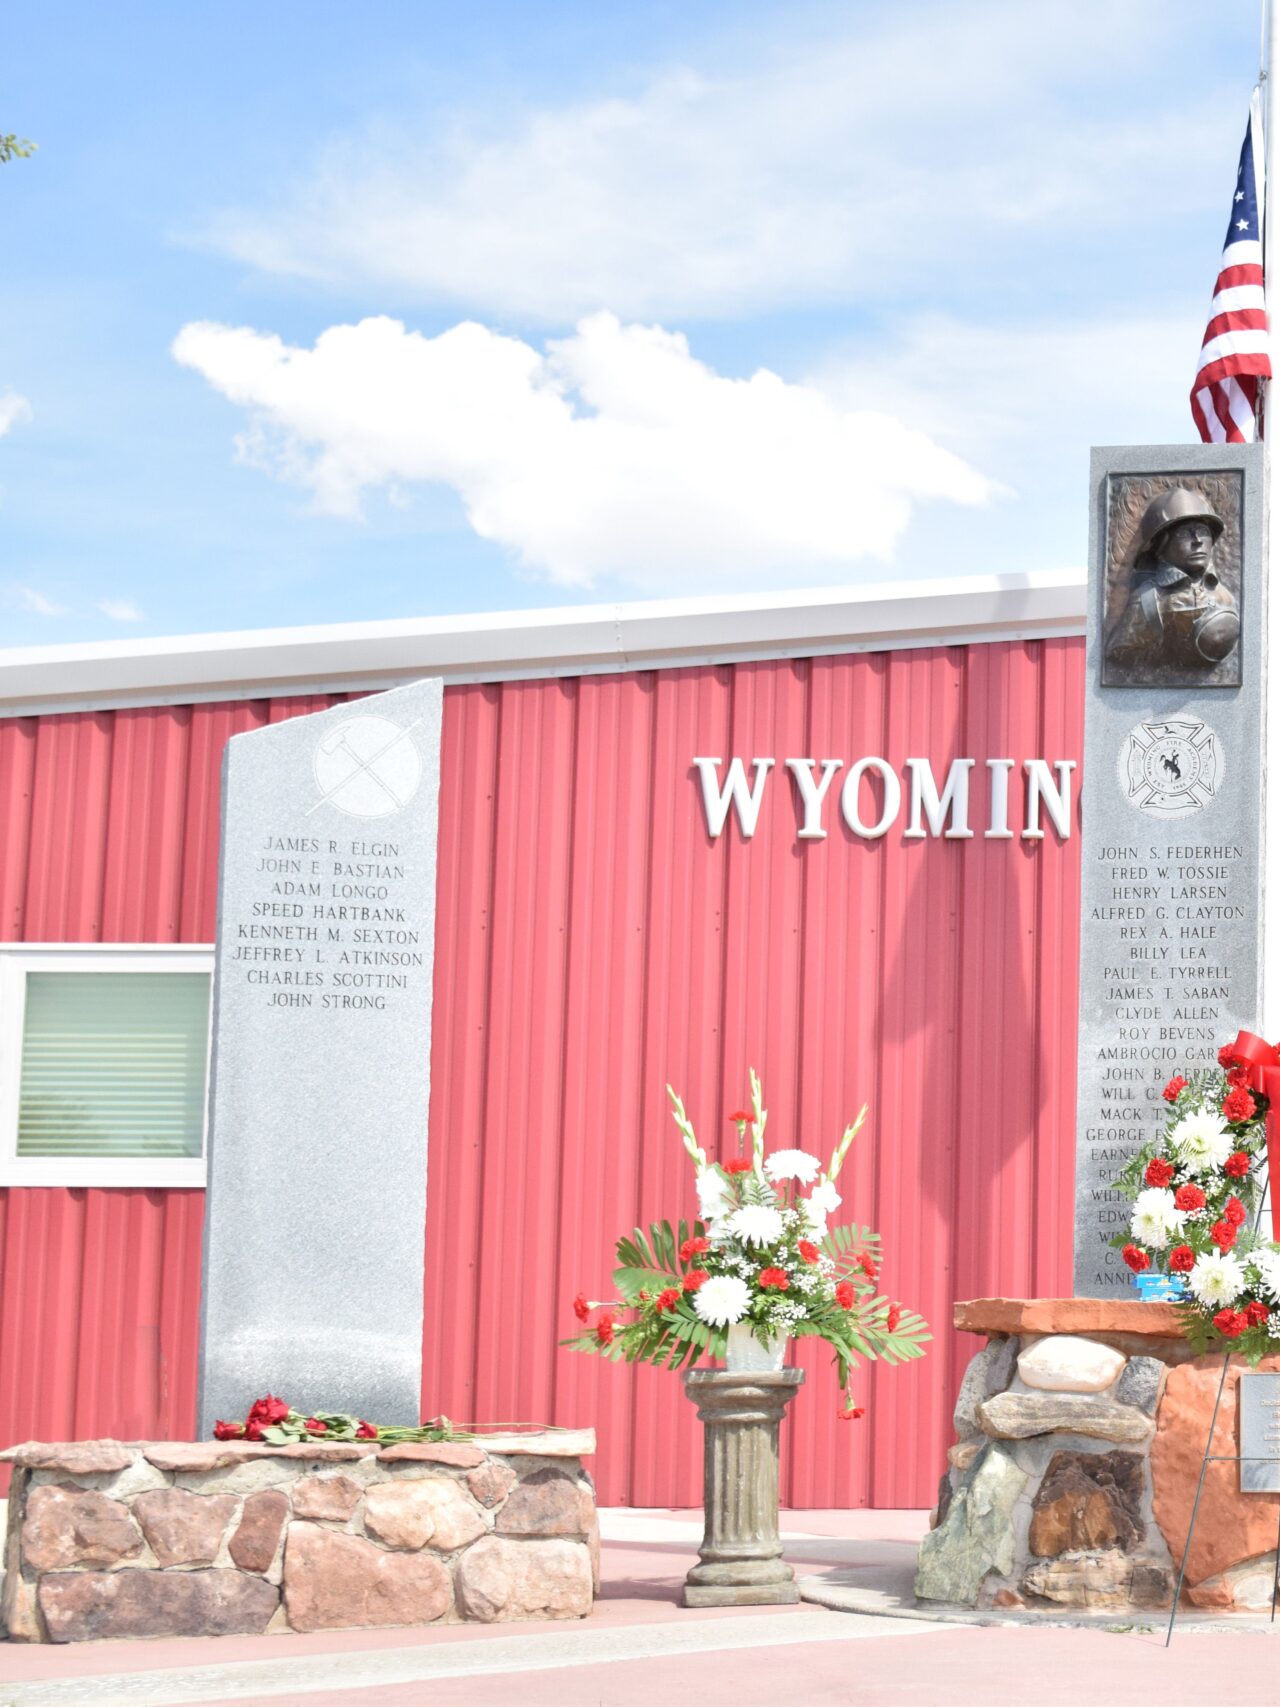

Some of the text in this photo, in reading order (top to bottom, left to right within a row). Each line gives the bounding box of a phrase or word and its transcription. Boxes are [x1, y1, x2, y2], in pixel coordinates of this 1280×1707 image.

[693, 756, 1077, 840] WYOMIN
[264, 837, 319, 852] JAMES
[352, 842, 399, 856] ELGIN
[1098, 848, 1138, 860] JOHN
[1167, 847, 1243, 859] FEDERHEN
[256, 858, 301, 872] JOHN
[333, 862, 404, 878] BASTIAN
[1112, 867, 1148, 879] FRED
[1177, 867, 1228, 879] TOSSIE
[271, 882, 388, 900] ADAM LONGO
[1113, 886, 1227, 899] HENRY LARSEN
[253, 903, 405, 922] SPEED HARTBANK
[1091, 907, 1145, 919] ALFRED
[1176, 906, 1245, 919] CLAYTON
[238, 924, 317, 940] KENNETH
[353, 929, 419, 944] SEXTON
[1120, 927, 1147, 938] REX
[1180, 926, 1217, 938] HALE
[232, 946, 306, 962] JEFFREY
[339, 951, 423, 966] ATKINSON
[1130, 947, 1207, 959] BILLY LEA
[247, 970, 407, 988] CHARLES SCOTTINI
[1104, 968, 1139, 979] PAUL
[1170, 967, 1231, 979] TYRRELL
[1106, 988, 1154, 999] JAMES
[1184, 987, 1230, 999] SABAN
[267, 993, 386, 1009] JOHN STRONG
[1116, 1007, 1219, 1019] CLYDE ALLEN
[1119, 1027, 1215, 1040] ROY BEVENS
[1098, 1047, 1221, 1060] AMBROCIO GAR
[1102, 1068, 1144, 1080] JOHN
[1102, 1088, 1135, 1100] WILL
[1100, 1108, 1142, 1120] MACK
[1086, 1129, 1146, 1141] GEORGE
